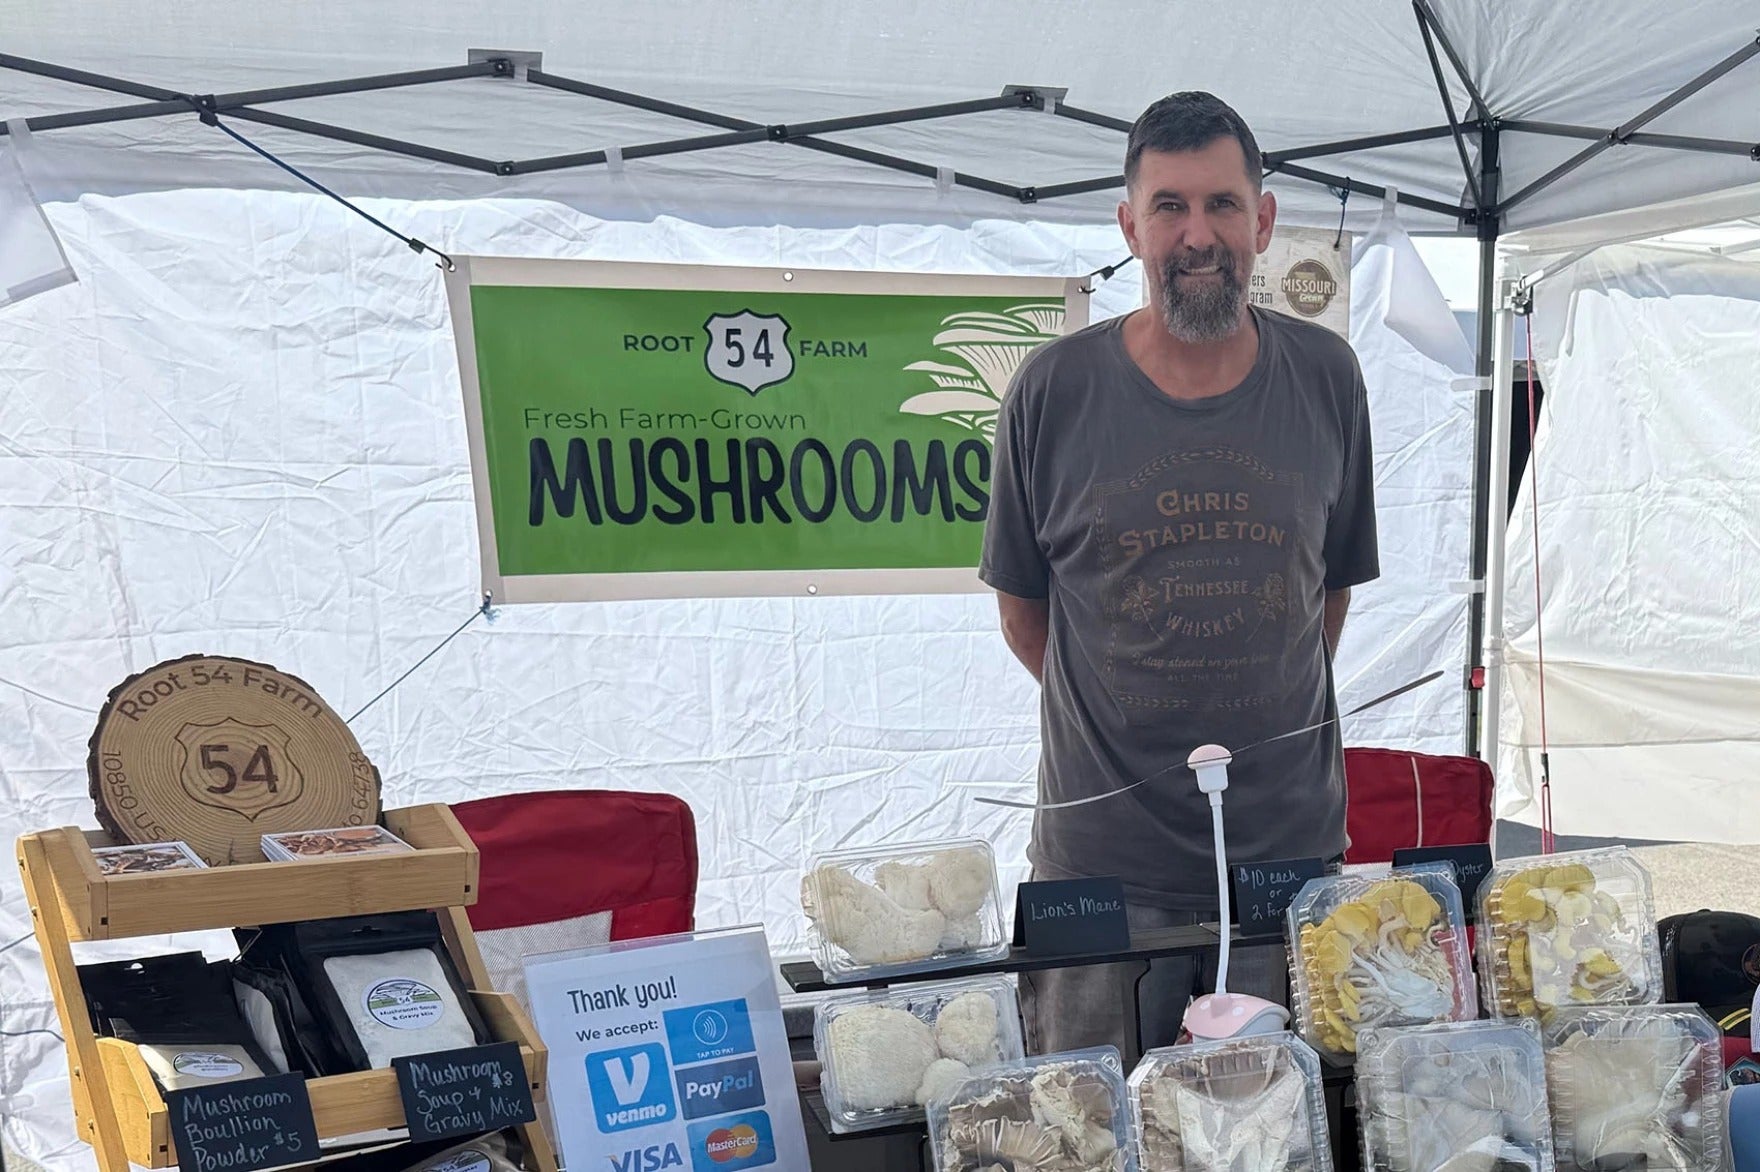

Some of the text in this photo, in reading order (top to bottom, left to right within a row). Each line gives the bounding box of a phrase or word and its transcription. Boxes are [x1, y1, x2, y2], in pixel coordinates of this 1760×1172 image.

[1282, 278, 1335, 295] MISSOURI
[623, 328, 868, 369] ROOT 54 FARM
[524, 407, 806, 430] Fresh Farm-Grown
[528, 437, 991, 528] MUSHROOMS
[1156, 489, 1249, 516] CHRIS
[1118, 521, 1286, 558] STAPLETON
[1167, 559, 1220, 570] SMOOTH
[1159, 576, 1250, 604] TENNESSEE
[1166, 607, 1247, 639] WHISKEY
[117, 664, 323, 722] Root 54 Farm
[102, 750, 139, 810] 10850
[199, 744, 279, 794] 54
[349, 751, 372, 810] 64738
[1269, 869, 1301, 884] each
[1269, 889, 1283, 898] or
[1031, 896, 1121, 921] Lion's Mane
[1251, 904, 1263, 920] 2
[567, 975, 677, 1014] Thank you!
[575, 1020, 659, 1042] We accept:
[696, 1047, 735, 1059] TAP TO PAY
[408, 1061, 502, 1089] Mushroom
[685, 1070, 754, 1100] PayPal
[183, 1092, 292, 1122] Mushroom
[416, 1088, 464, 1115] Soup
[424, 1096, 523, 1134] Gravy Mix
[605, 1103, 667, 1127] venmo
[184, 1115, 281, 1147] Boullion
[707, 1134, 757, 1154] MasterCard
[191, 1142, 270, 1172] Powder
[606, 1142, 683, 1172] VISA
